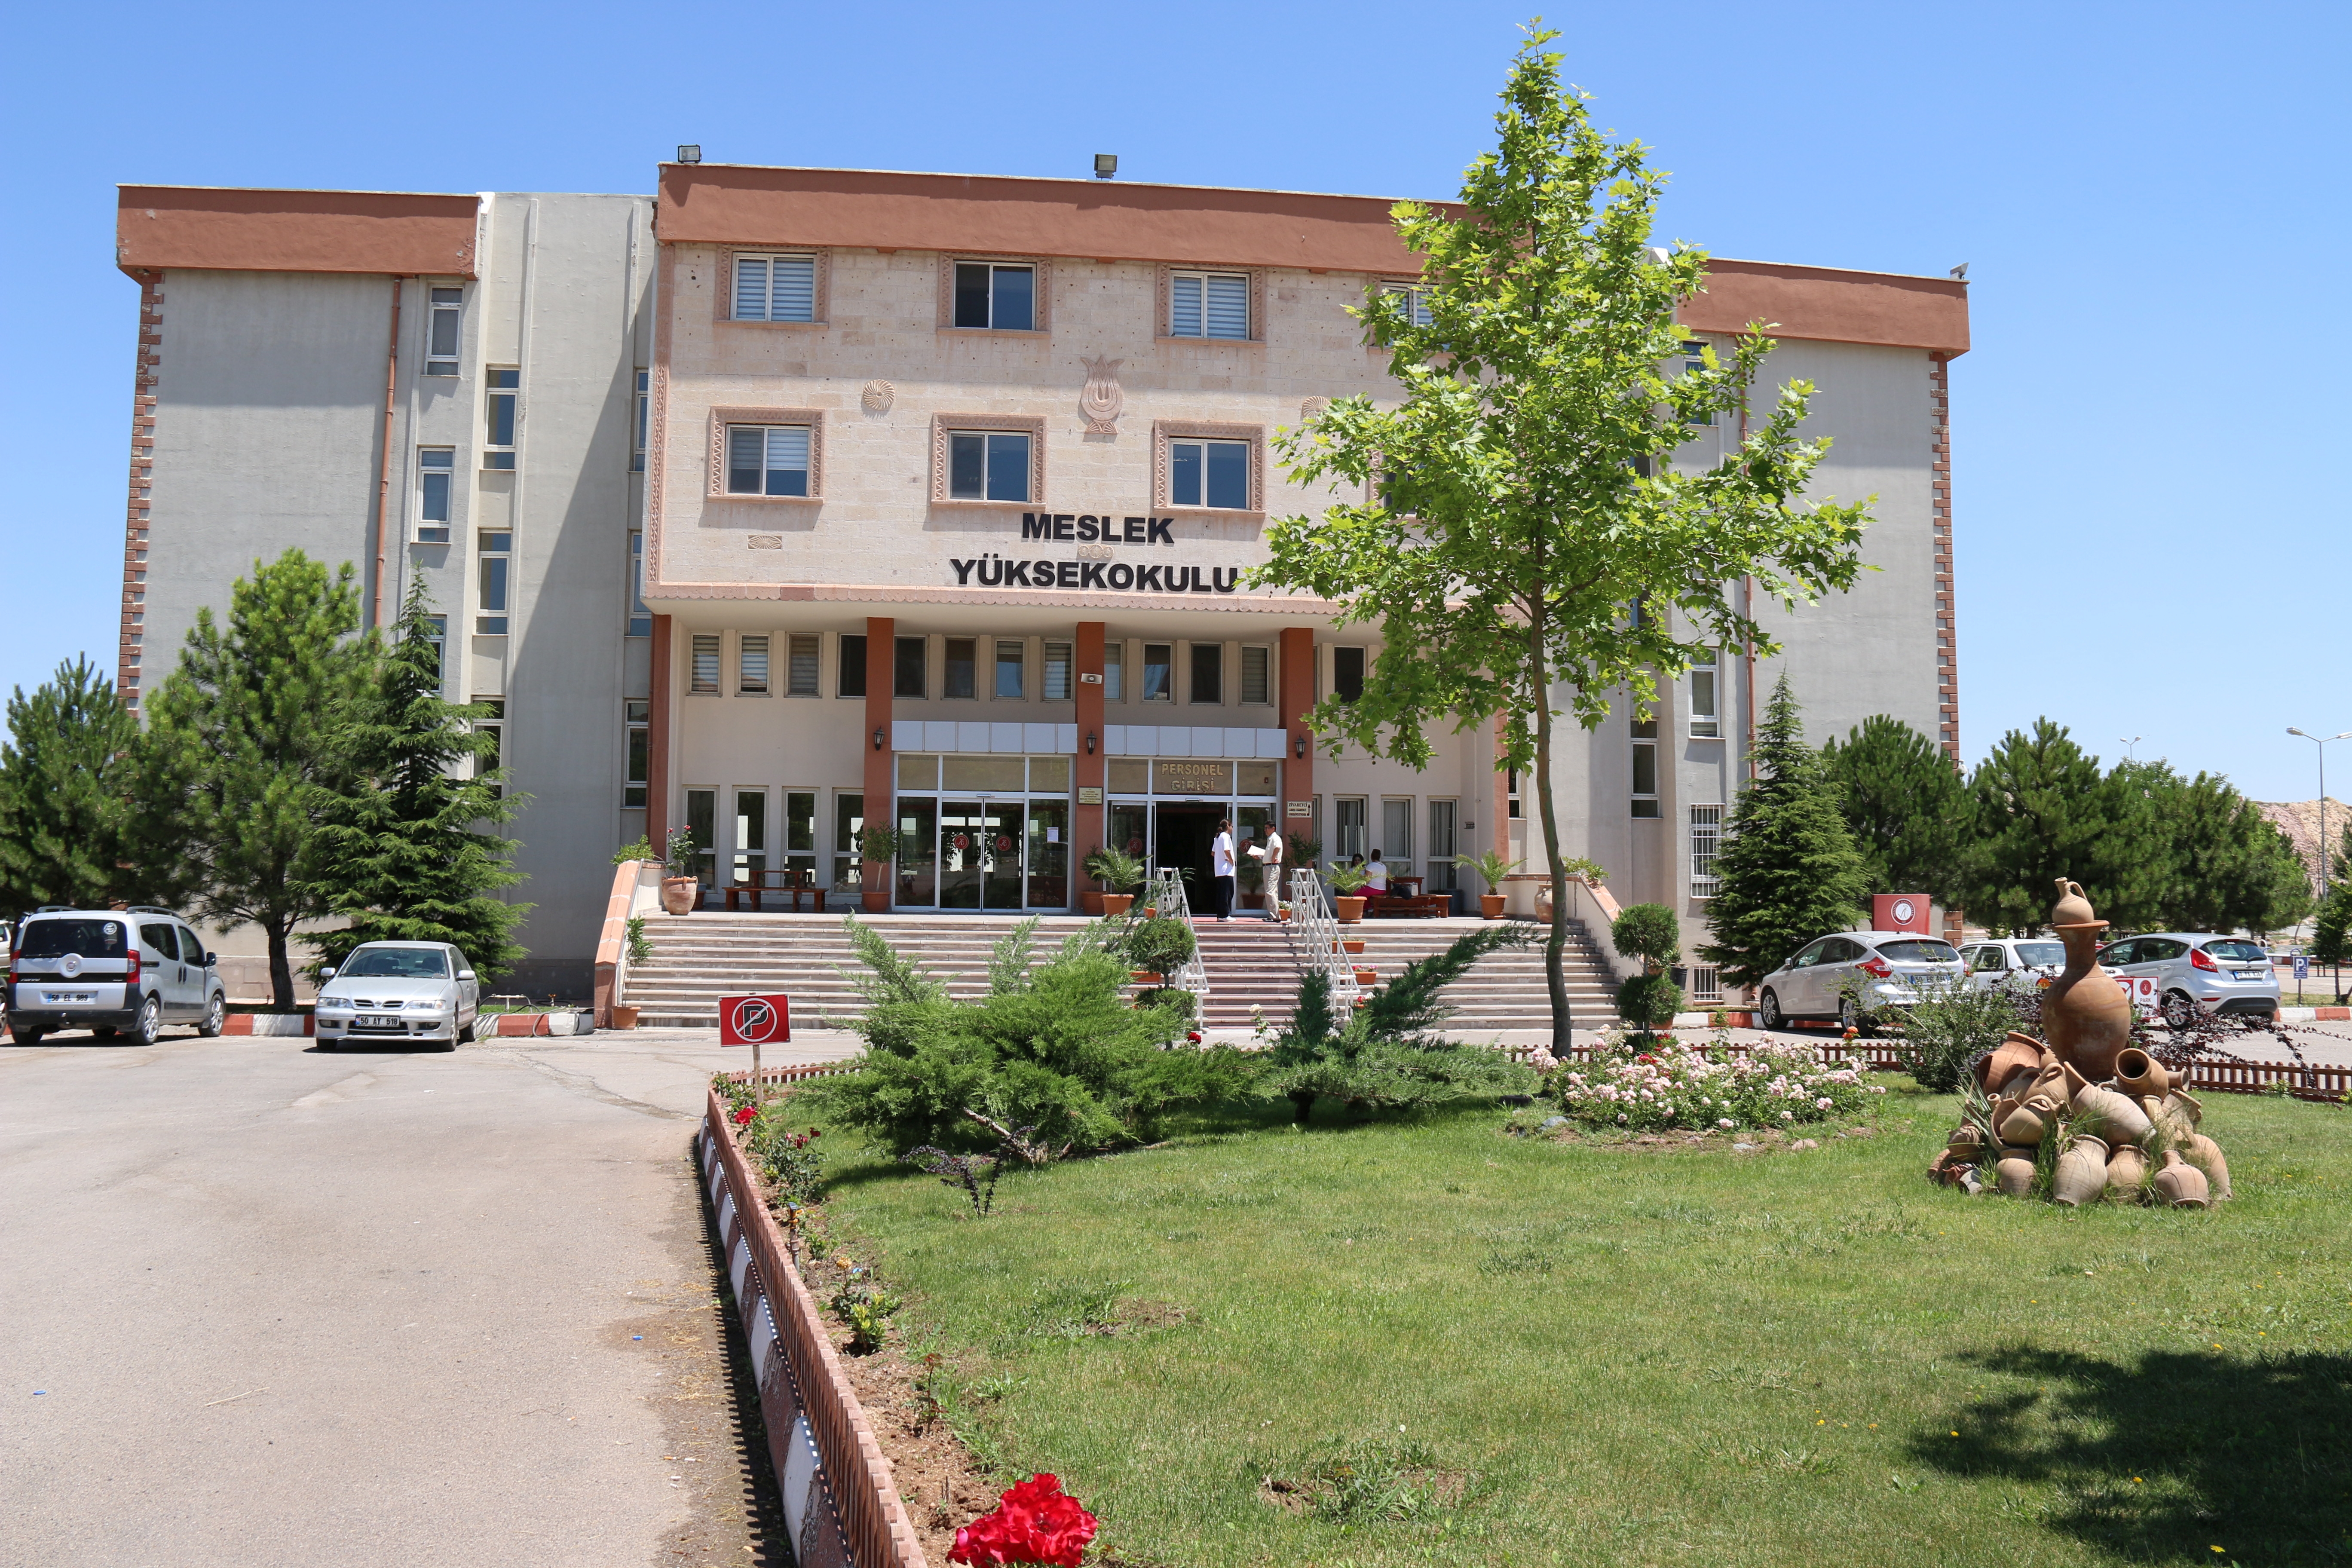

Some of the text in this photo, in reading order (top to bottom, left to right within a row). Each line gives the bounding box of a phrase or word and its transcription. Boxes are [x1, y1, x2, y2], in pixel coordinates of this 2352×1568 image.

[1023, 513, 1174, 543] MESLEK
[950, 553, 1237, 592] YÜKSEKOKULU
[1162, 763, 1223, 775] PERSONEL
[1171, 777, 1214, 793] GİRİŞİ
[2296, 958, 2304, 971] P
